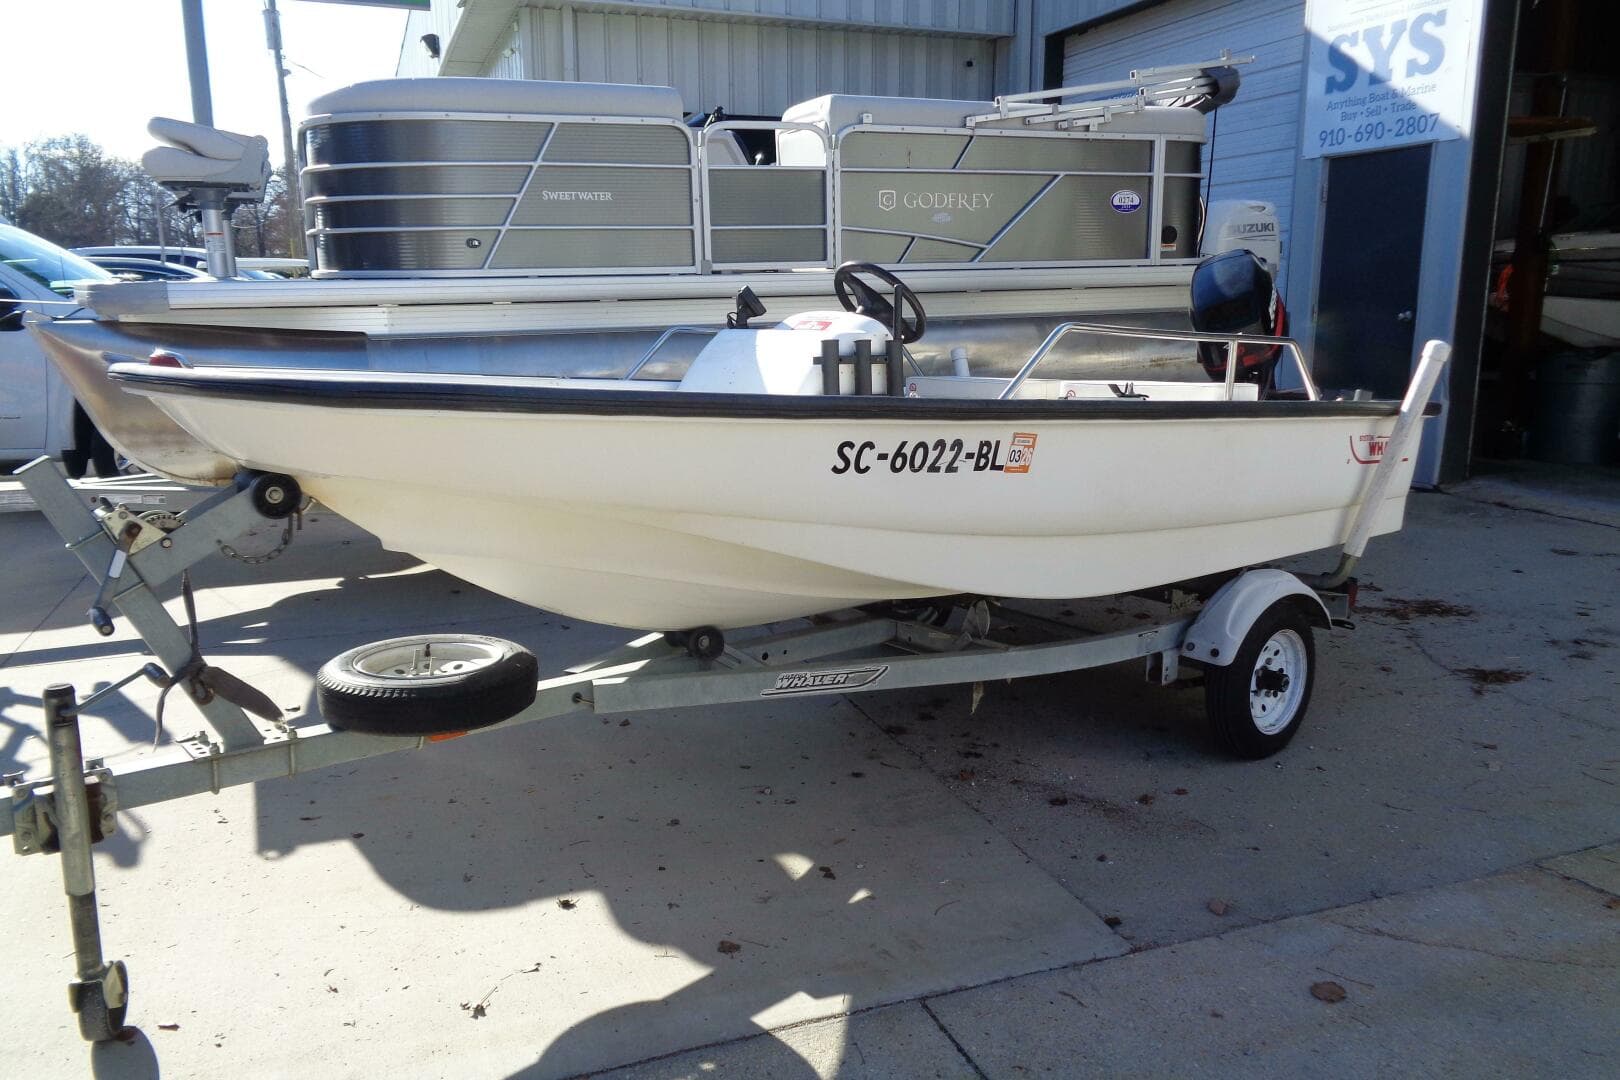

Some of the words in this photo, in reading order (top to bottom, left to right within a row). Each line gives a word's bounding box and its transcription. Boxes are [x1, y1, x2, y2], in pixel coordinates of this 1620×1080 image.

[1324, 9, 1448, 95] SYS
[1326, 96, 1368, 111] Anything
[1368, 90, 1390, 103] Boat
[1401, 83, 1437, 98] Marine
[1340, 111, 1358, 122] Buy
[1366, 106, 1382, 117] Sell
[1391, 101, 1417, 113] Trade
[1319, 112, 1440, 148] 910-690-2807
[903, 192, 994, 211] GODFREY
[831, 438, 1004, 475] SC-6022-BL
[1010, 449, 1021, 463] 03
[775, 673, 849, 690] WHALER
